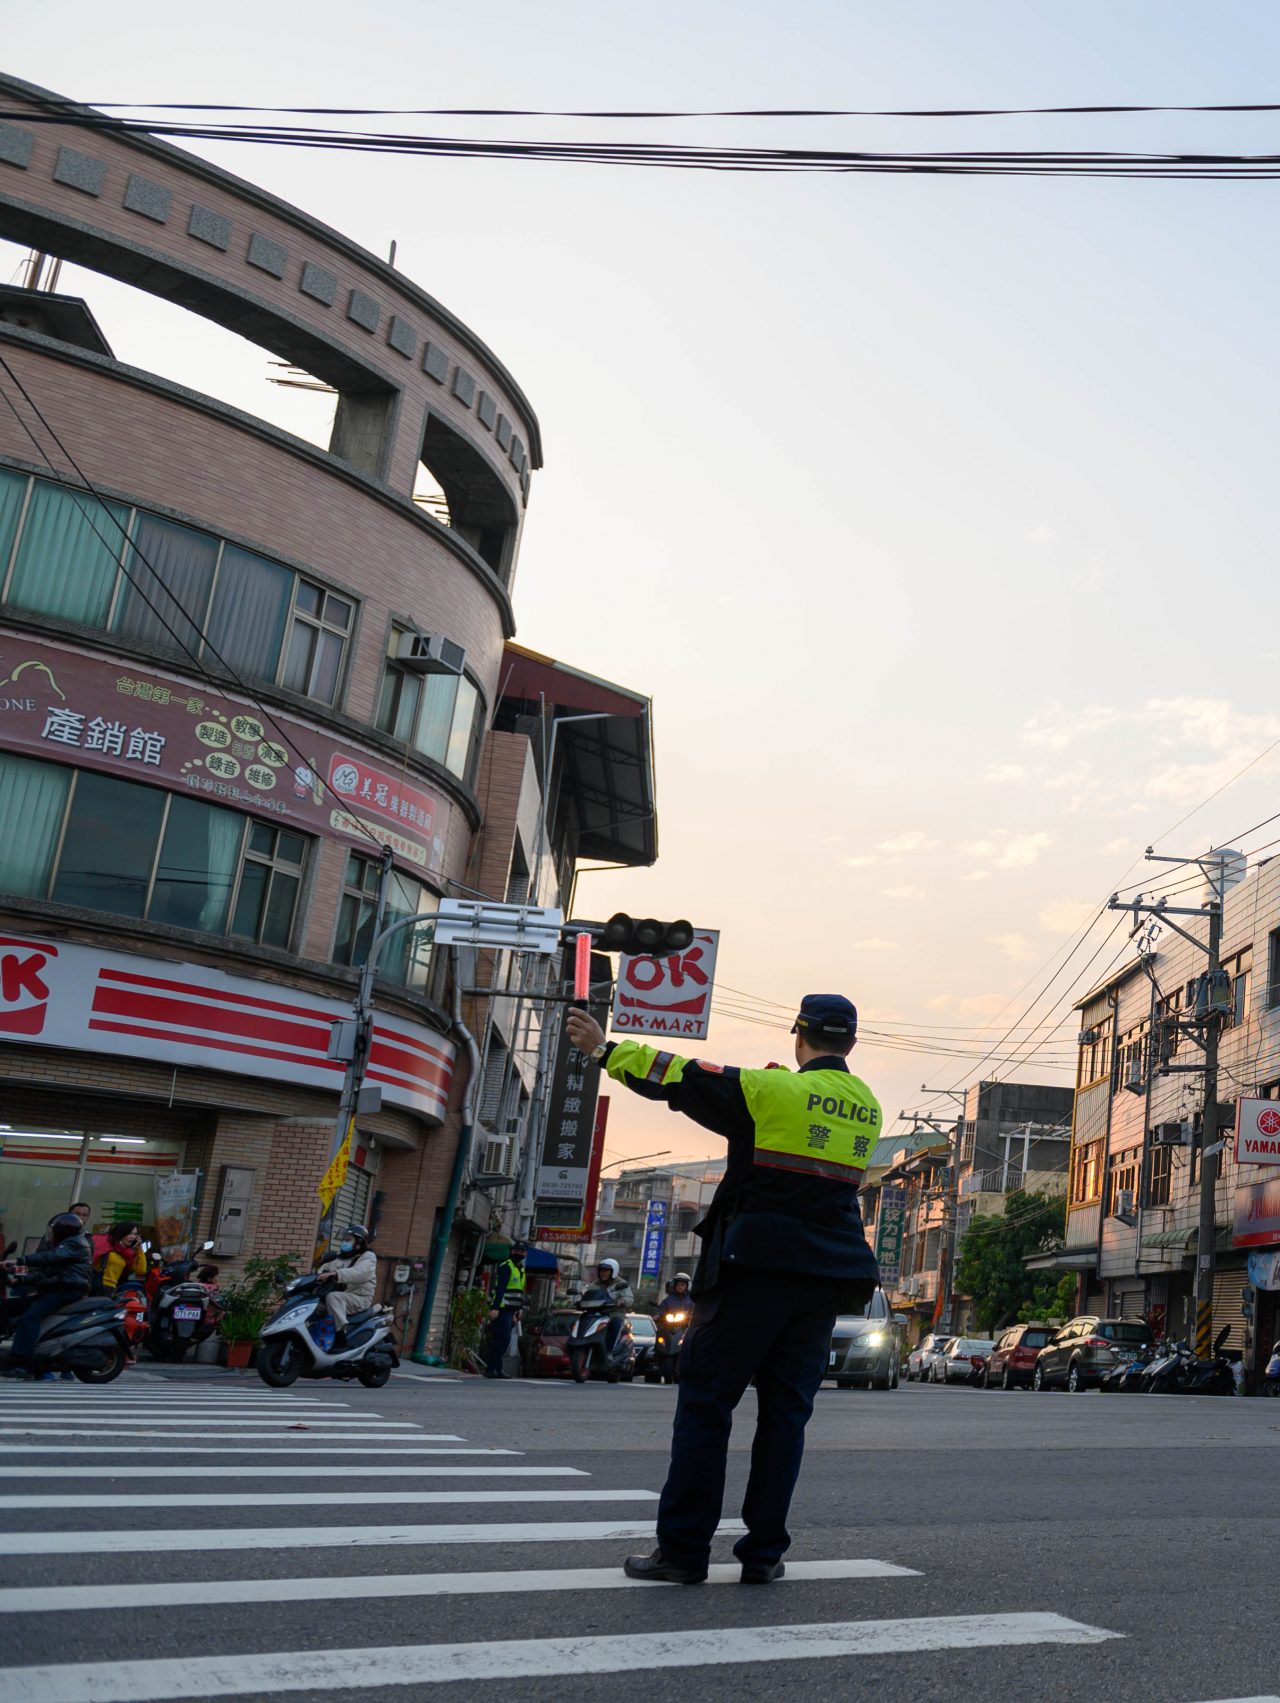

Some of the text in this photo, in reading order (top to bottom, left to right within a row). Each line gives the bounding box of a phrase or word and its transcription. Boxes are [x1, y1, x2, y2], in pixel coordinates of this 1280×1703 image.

[116, 676, 204, 716] 台灣第一家
[41, 706, 166, 766] 產銷館
[198, 724, 229, 746] 製造
[234, 719, 262, 739] 教學
[208, 756, 238, 777] 錄音
[260, 745, 285, 766] 演奏
[248, 767, 274, 788] 維修
[360, 777, 388, 807] 美冠
[625, 946, 709, 991] OK
[807, 1093, 877, 1126] POLICE
[805, 1124, 870, 1158] 警察
